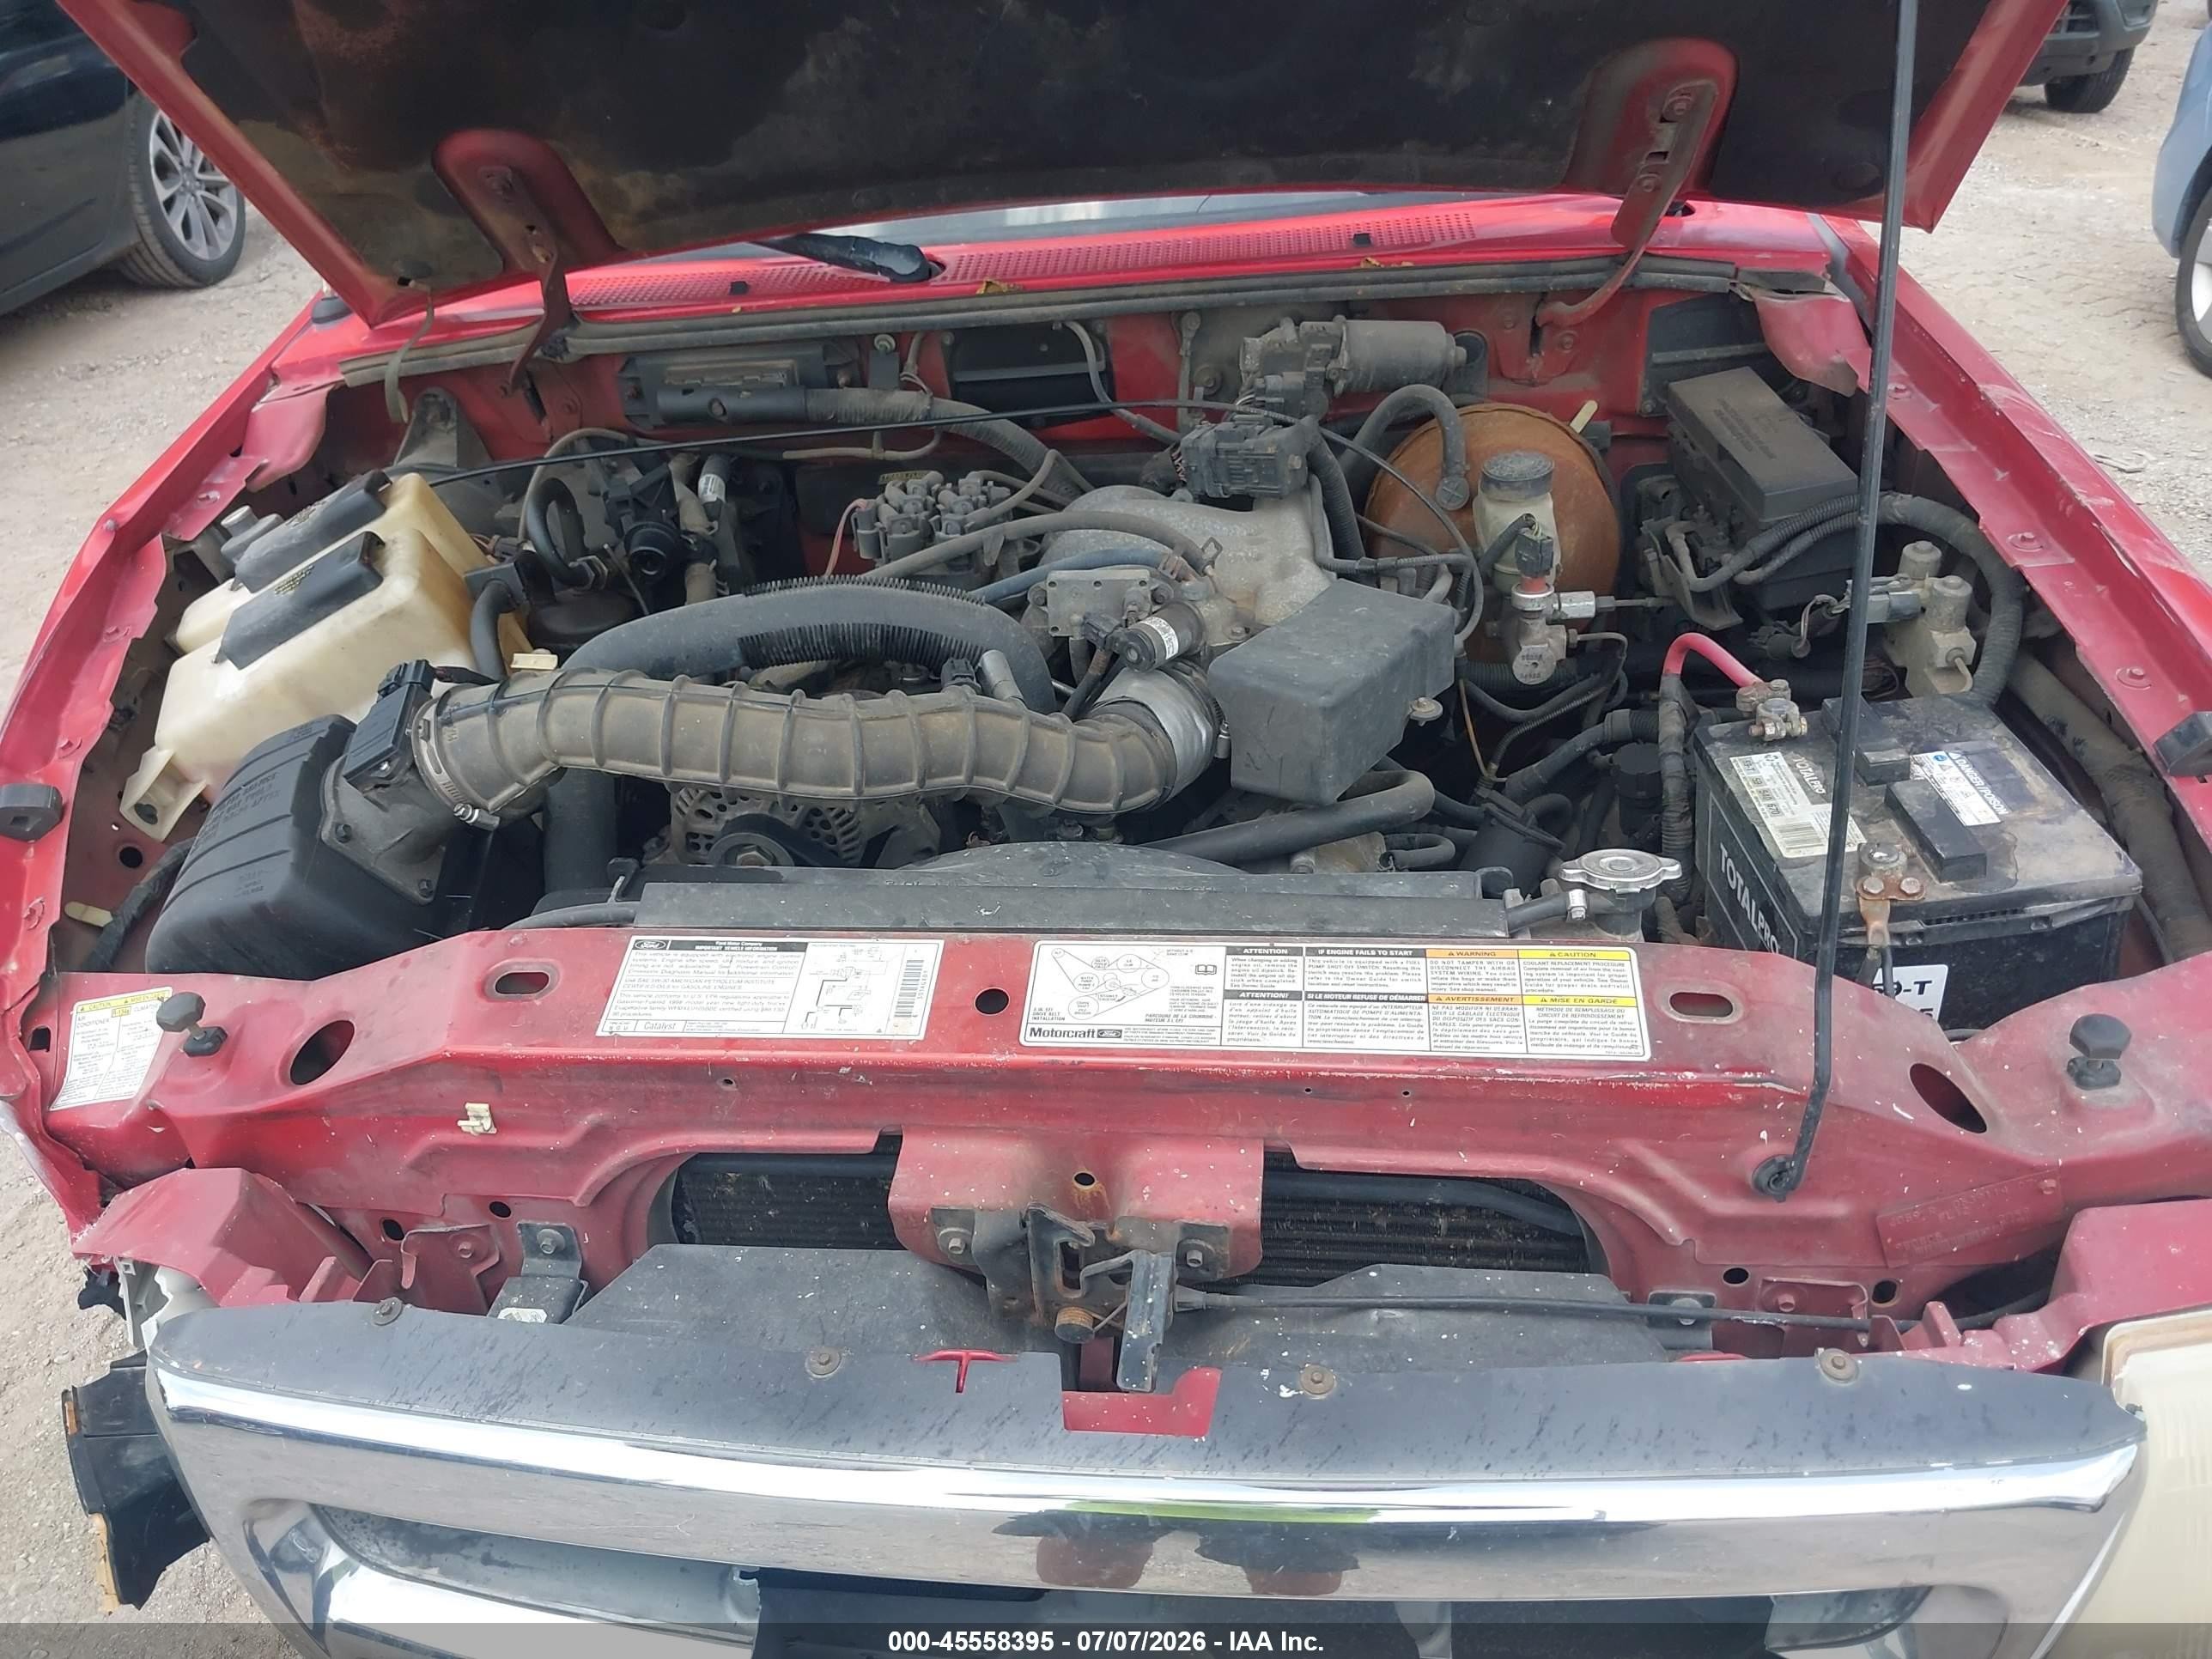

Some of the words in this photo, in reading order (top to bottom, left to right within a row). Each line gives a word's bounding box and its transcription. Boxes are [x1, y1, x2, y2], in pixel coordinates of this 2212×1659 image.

[1792, 757, 1826, 795] TOTALPRO
[1958, 758, 1984, 787] DANGER
[1982, 787, 2009, 815] POISON
[1719, 843, 1780, 954] TOTALPRO
[644, 1021, 677, 1030] Catalyst
